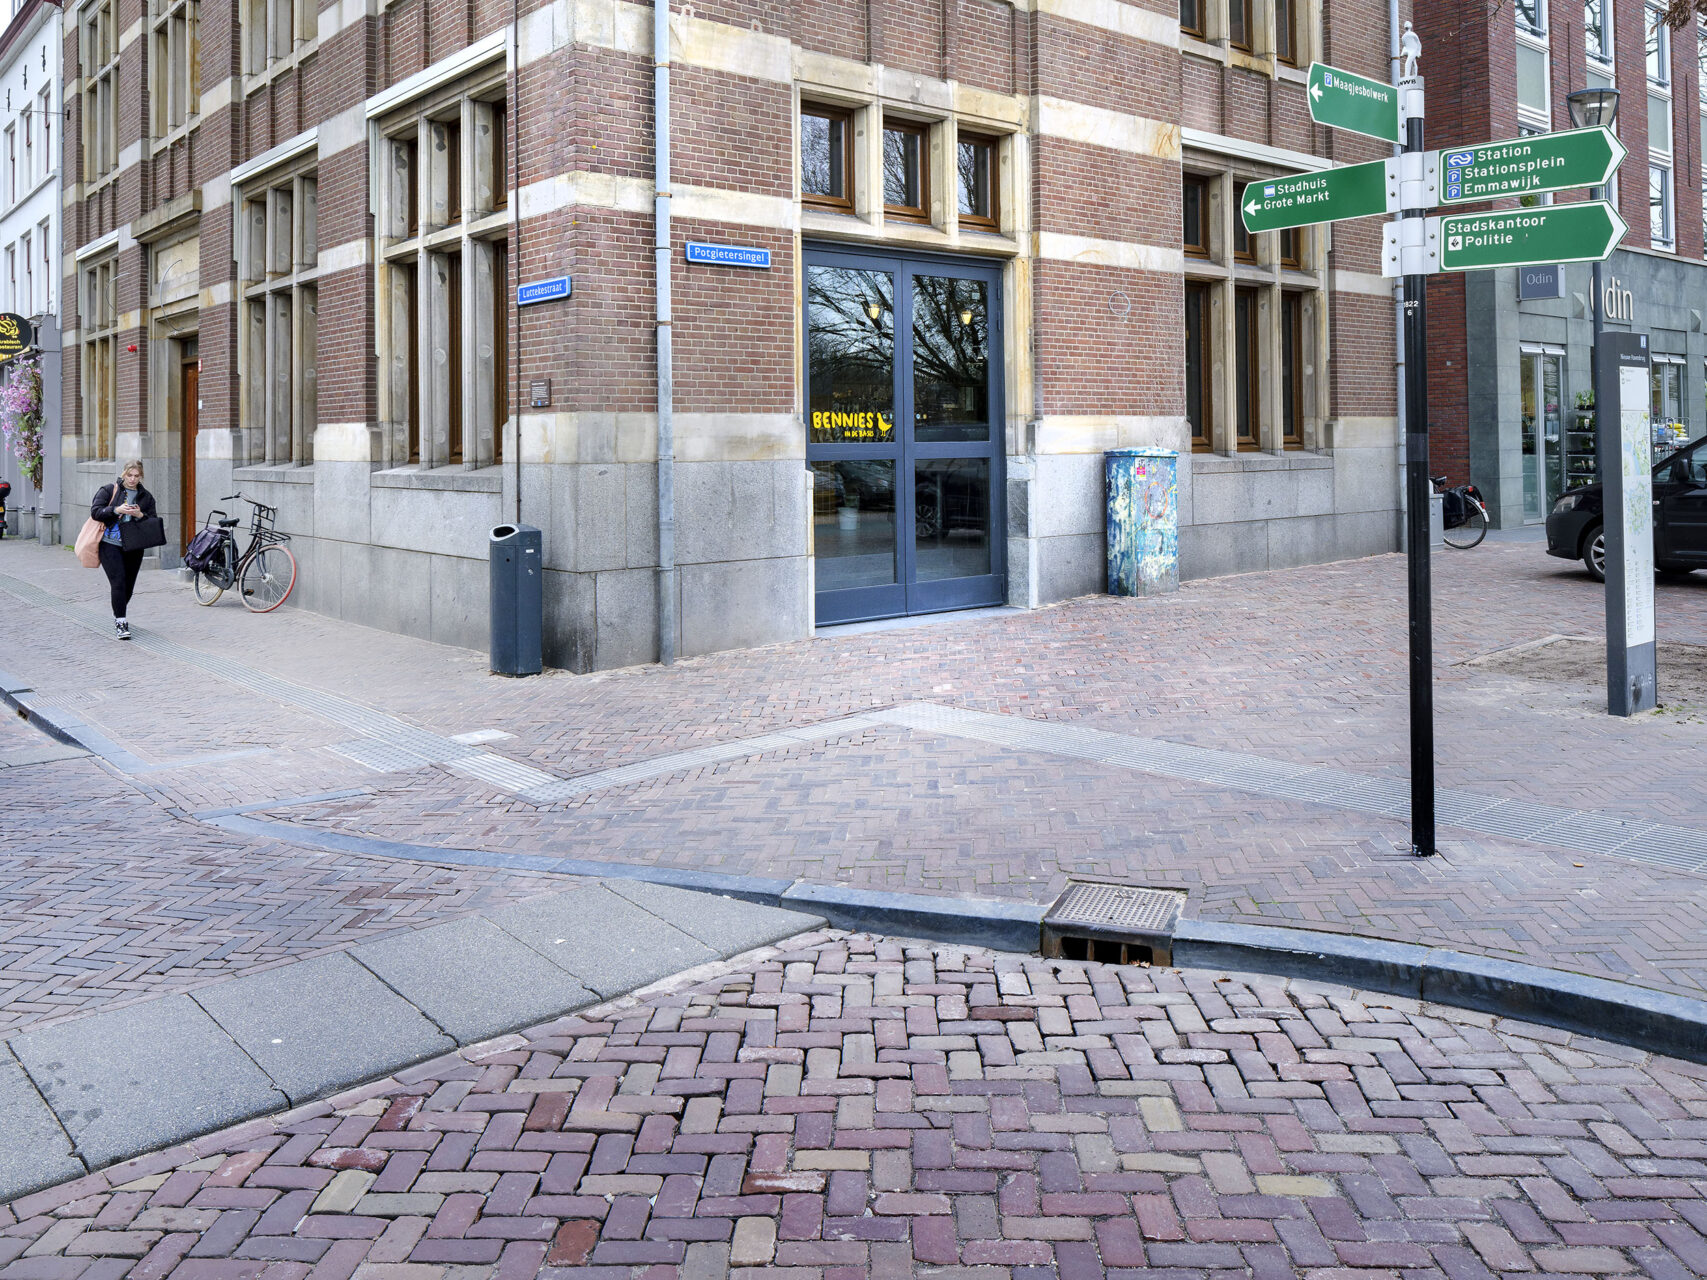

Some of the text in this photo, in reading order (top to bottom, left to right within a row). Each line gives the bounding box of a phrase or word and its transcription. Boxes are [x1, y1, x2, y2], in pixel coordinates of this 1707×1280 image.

[1333, 76, 1389, 103] Maagjesbolwerk
[1478, 146, 1531, 161] Station
[1465, 156, 1565, 179] Stationsplein
[1277, 178, 1327, 195] Stadhuis
[1464, 175, 1541, 194] Emmawijk
[1264, 190, 1330, 210] Grote Markt
[1448, 216, 1547, 234] Stadskantoor
[1465, 233, 1513, 247] Politie
[694, 247, 765, 263] Potgietersingel
[1526, 273, 1553, 285] Odin
[522, 283, 562, 298] Luttekestraat
[812, 411, 874, 429] BENNIES
